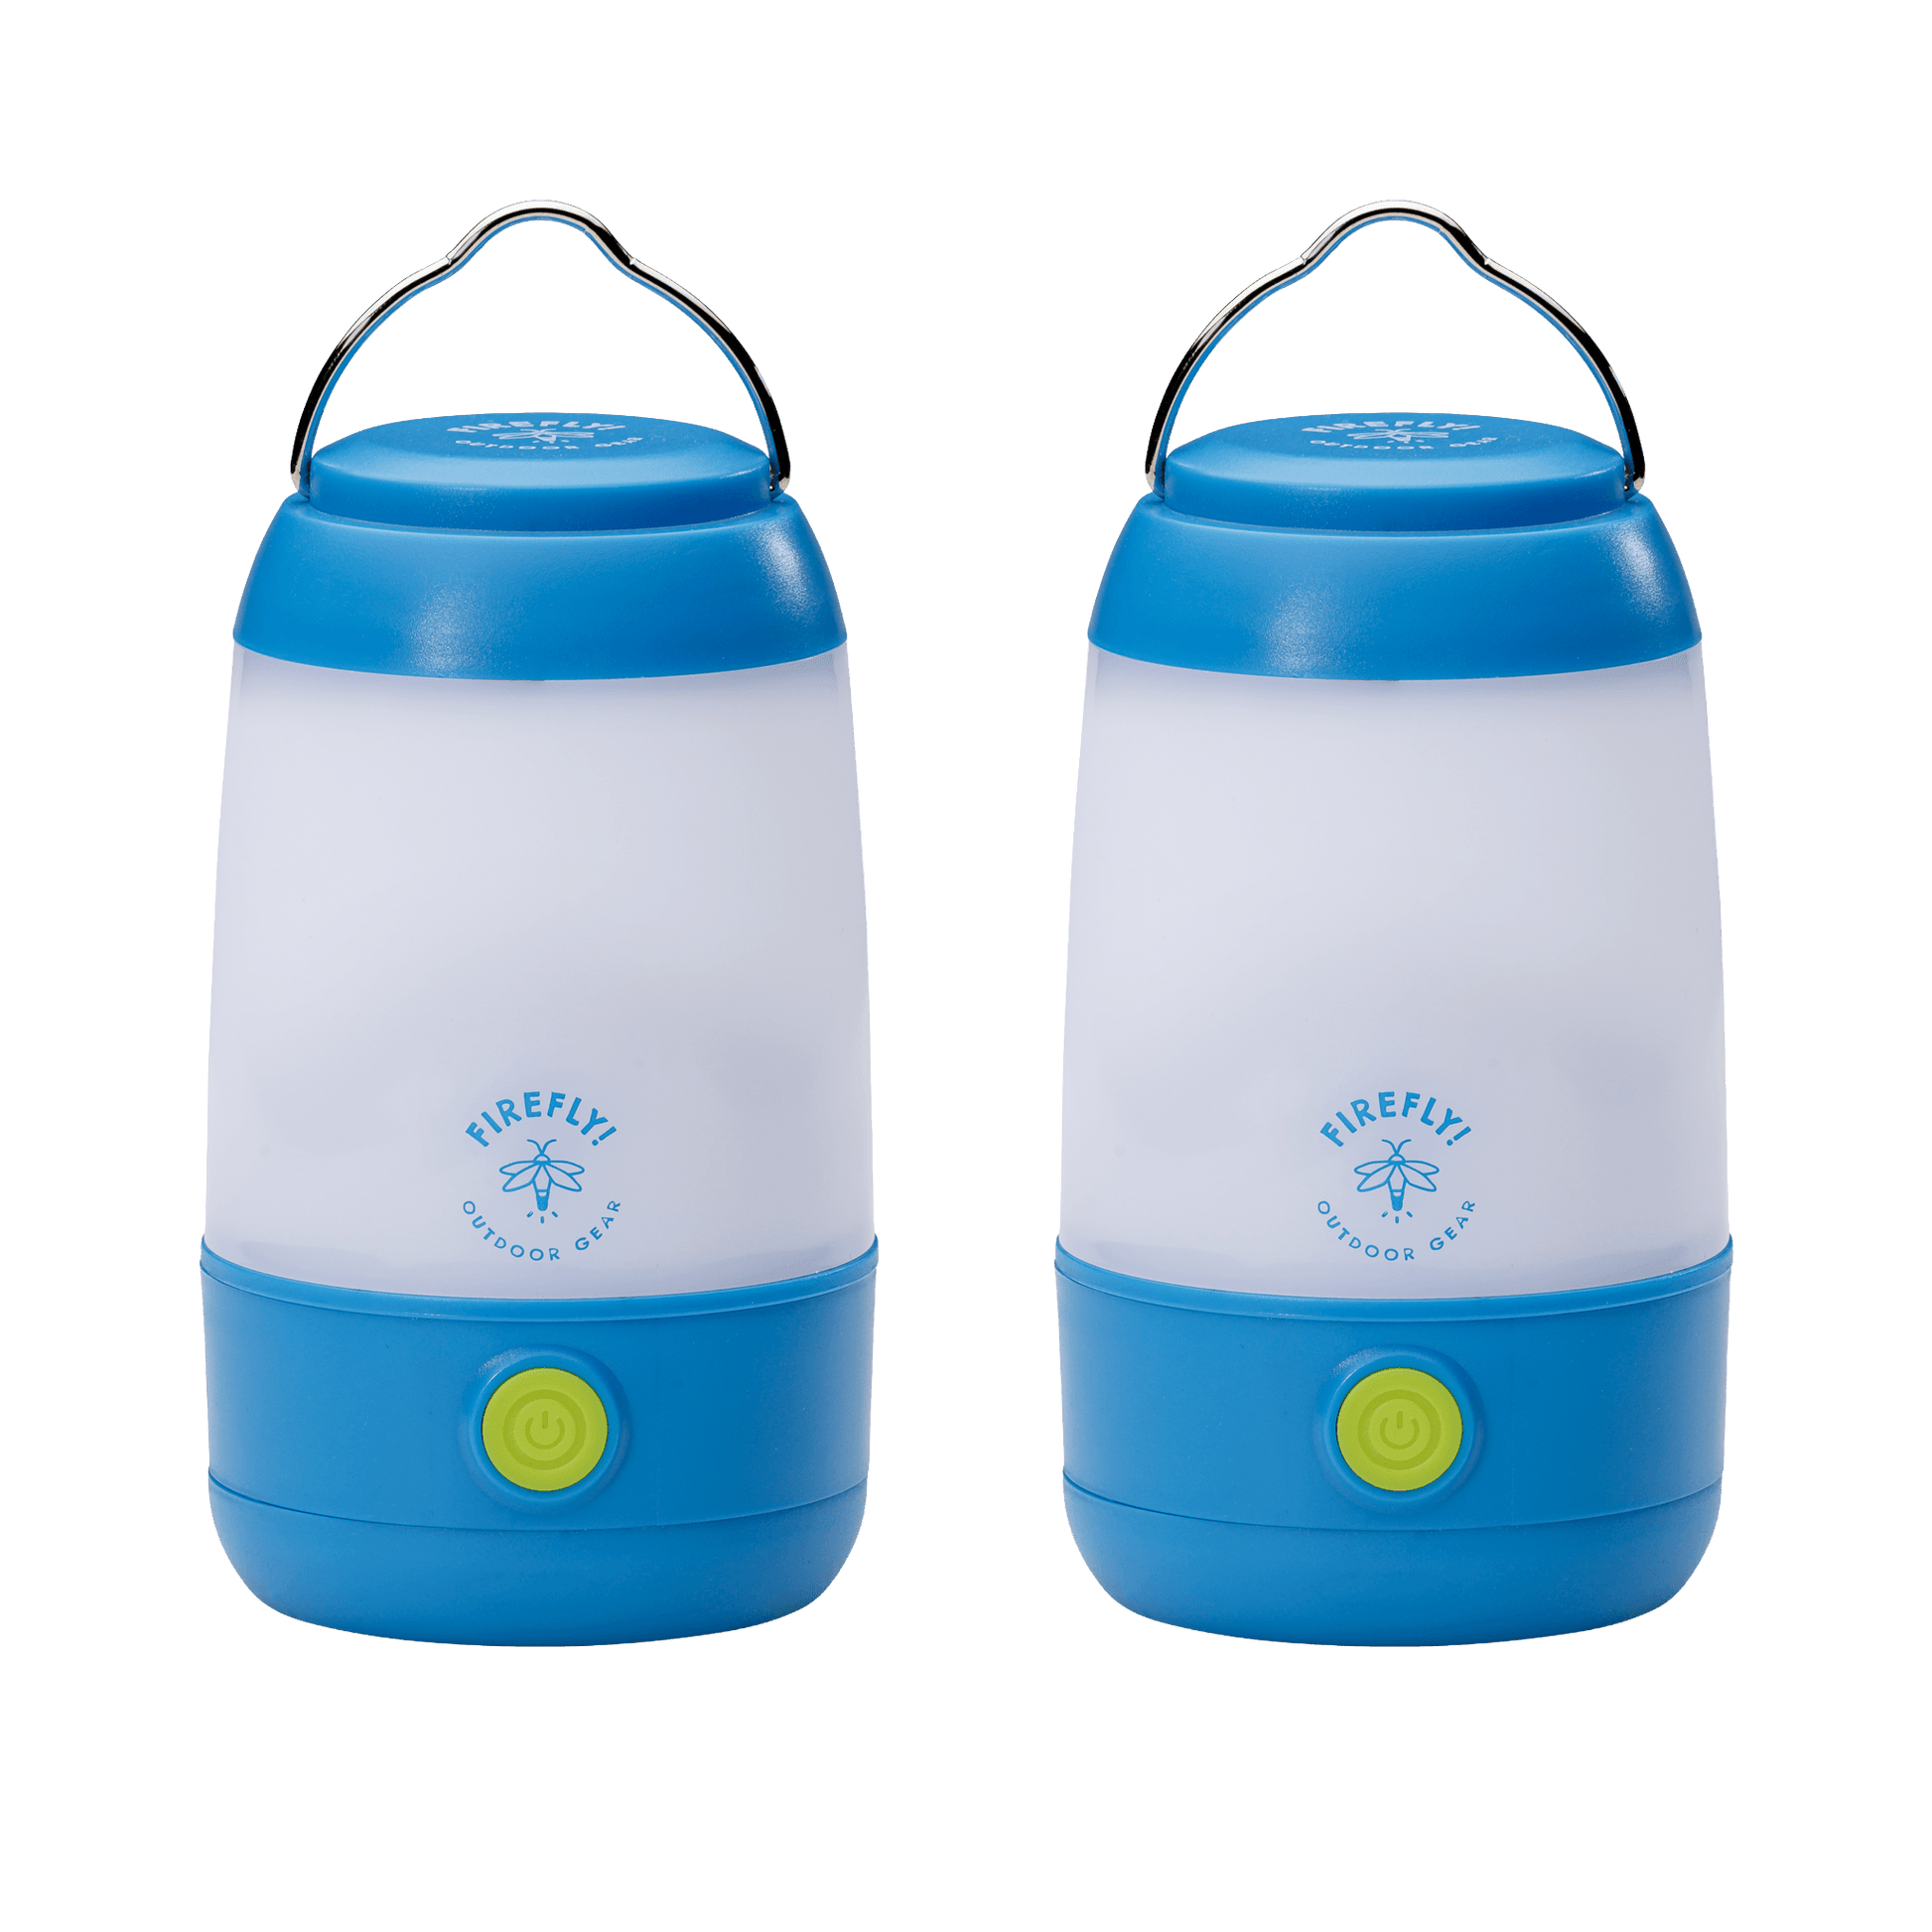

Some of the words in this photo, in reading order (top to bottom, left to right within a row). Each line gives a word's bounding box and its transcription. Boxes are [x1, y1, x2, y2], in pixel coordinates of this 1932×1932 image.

[465, 1091, 617, 1148] FIREFLY!
[1319, 1091, 1471, 1148] FIREFLY!
[463, 1200, 560, 1261] OUTDOOR
[575, 1200, 621, 1251] GEAR
[1317, 1200, 1415, 1261] OUTDOOR
[1430, 1200, 1475, 1251] GEAR
